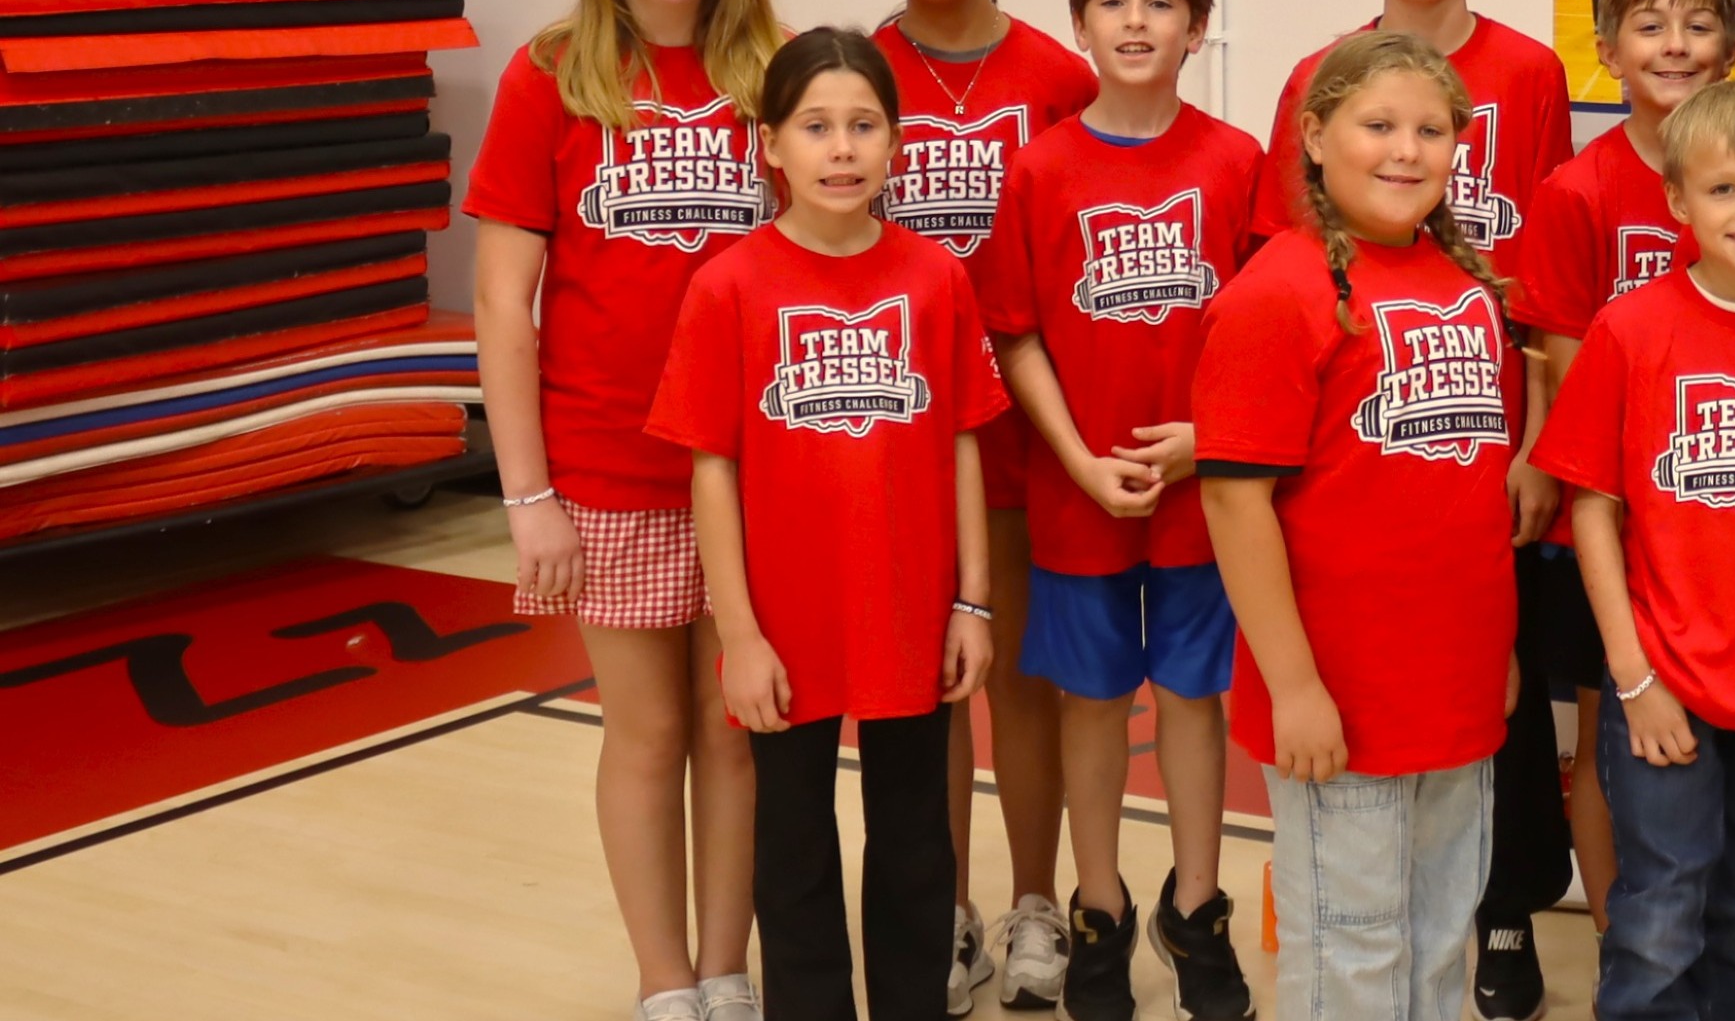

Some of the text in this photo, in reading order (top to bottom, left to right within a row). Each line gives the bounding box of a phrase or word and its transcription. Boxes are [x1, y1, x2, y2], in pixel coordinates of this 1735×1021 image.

[626, 127, 731, 161] TEAM
[903, 140, 1003, 172] TEAM
[602, 159, 760, 197] TRESSEL
[884, 170, 1004, 205] TRESSE
[623, 208, 745, 224] FITNESS CHALLENGE
[951, 215, 993, 227] CHALLE
[1098, 222, 1184, 256] TEAM
[1087, 248, 1201, 287] TRESSEL
[1635, 251, 1672, 278] TE
[1100, 286, 1193, 308] FITNESS CHALLENGE
[800, 328, 889, 360] TEAM
[1404, 324, 1490, 365] TEAM
[780, 357, 910, 392] TRESSEL
[1383, 361, 1502, 408] TRESSE
[800, 400, 842, 415] FITNESS
[1400, 415, 1503, 437] FITNESS CHALLENGE
[1693, 474, 1735, 488] FITNESS
[1487, 929, 1524, 950] NIKE
